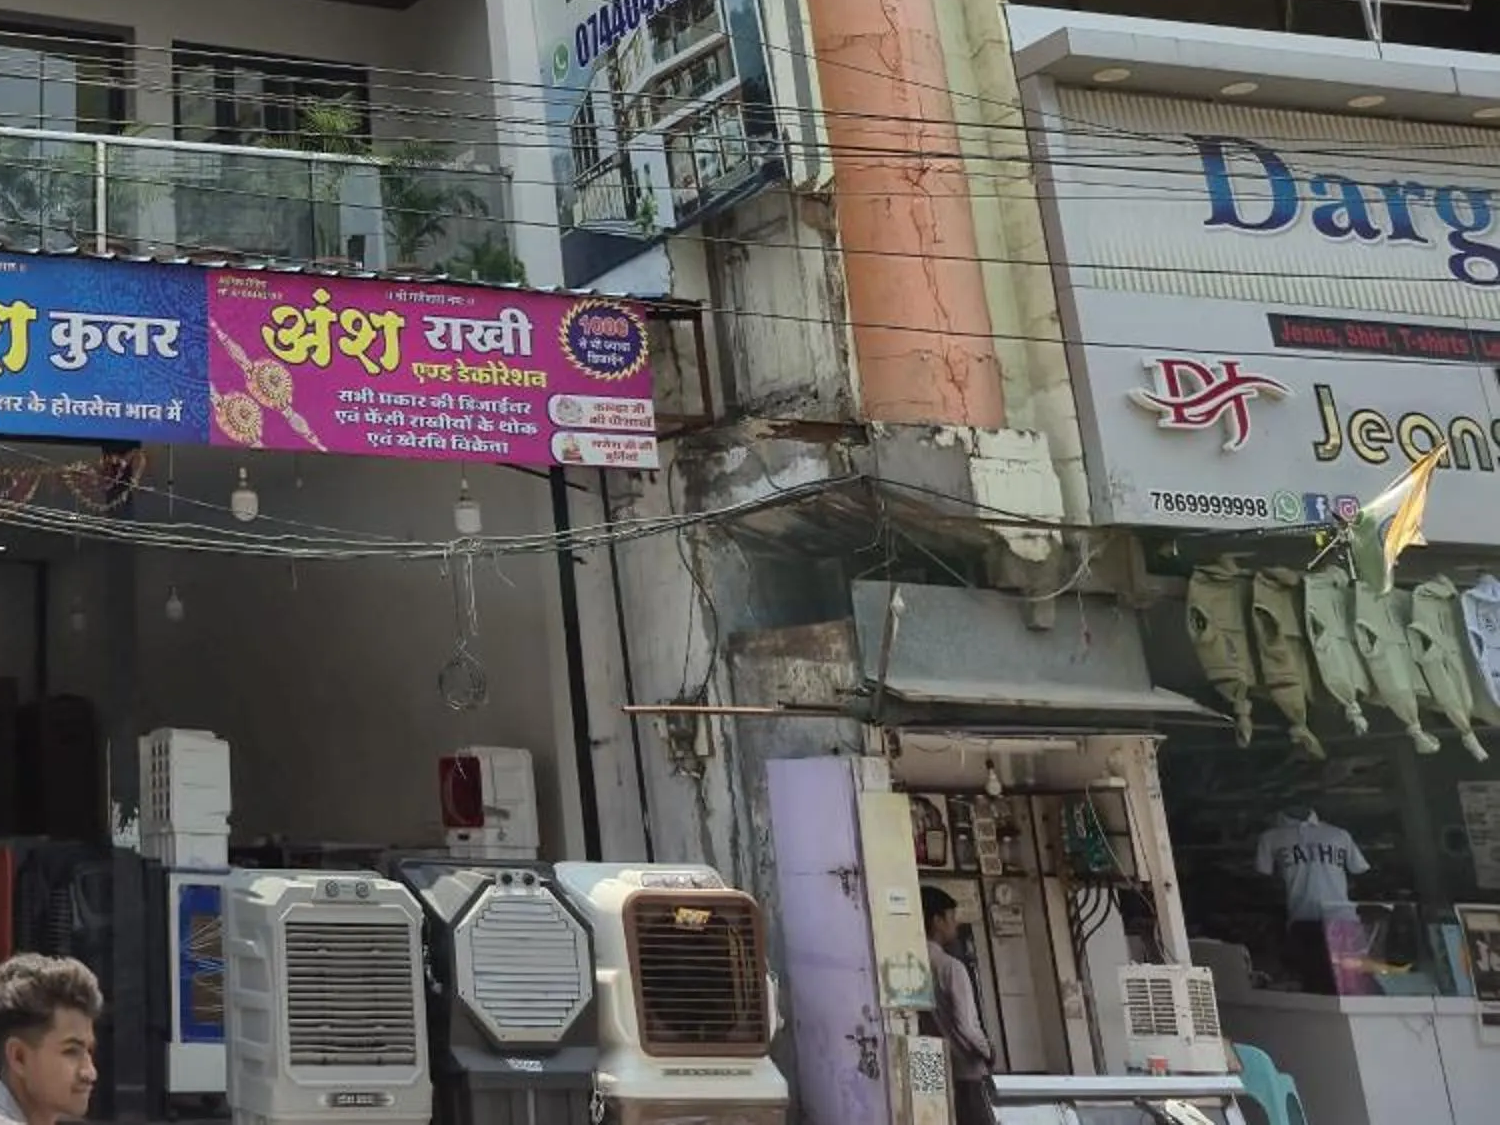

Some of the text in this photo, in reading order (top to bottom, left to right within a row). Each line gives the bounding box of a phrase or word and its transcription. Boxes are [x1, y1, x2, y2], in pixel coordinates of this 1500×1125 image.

[49, 309, 180, 370] कुलर
[260, 288, 533, 375] अंश राखी
[457, 358, 548, 388] डेकोरेशन
[27, 390, 47, 412] के
[51, 392, 121, 418] होलसेल
[125, 403, 162, 421] भाव
[166, 398, 184, 422] में
[1313, 383, 1500, 472] Jean
[1150, 491, 1268, 517] 7869999998
